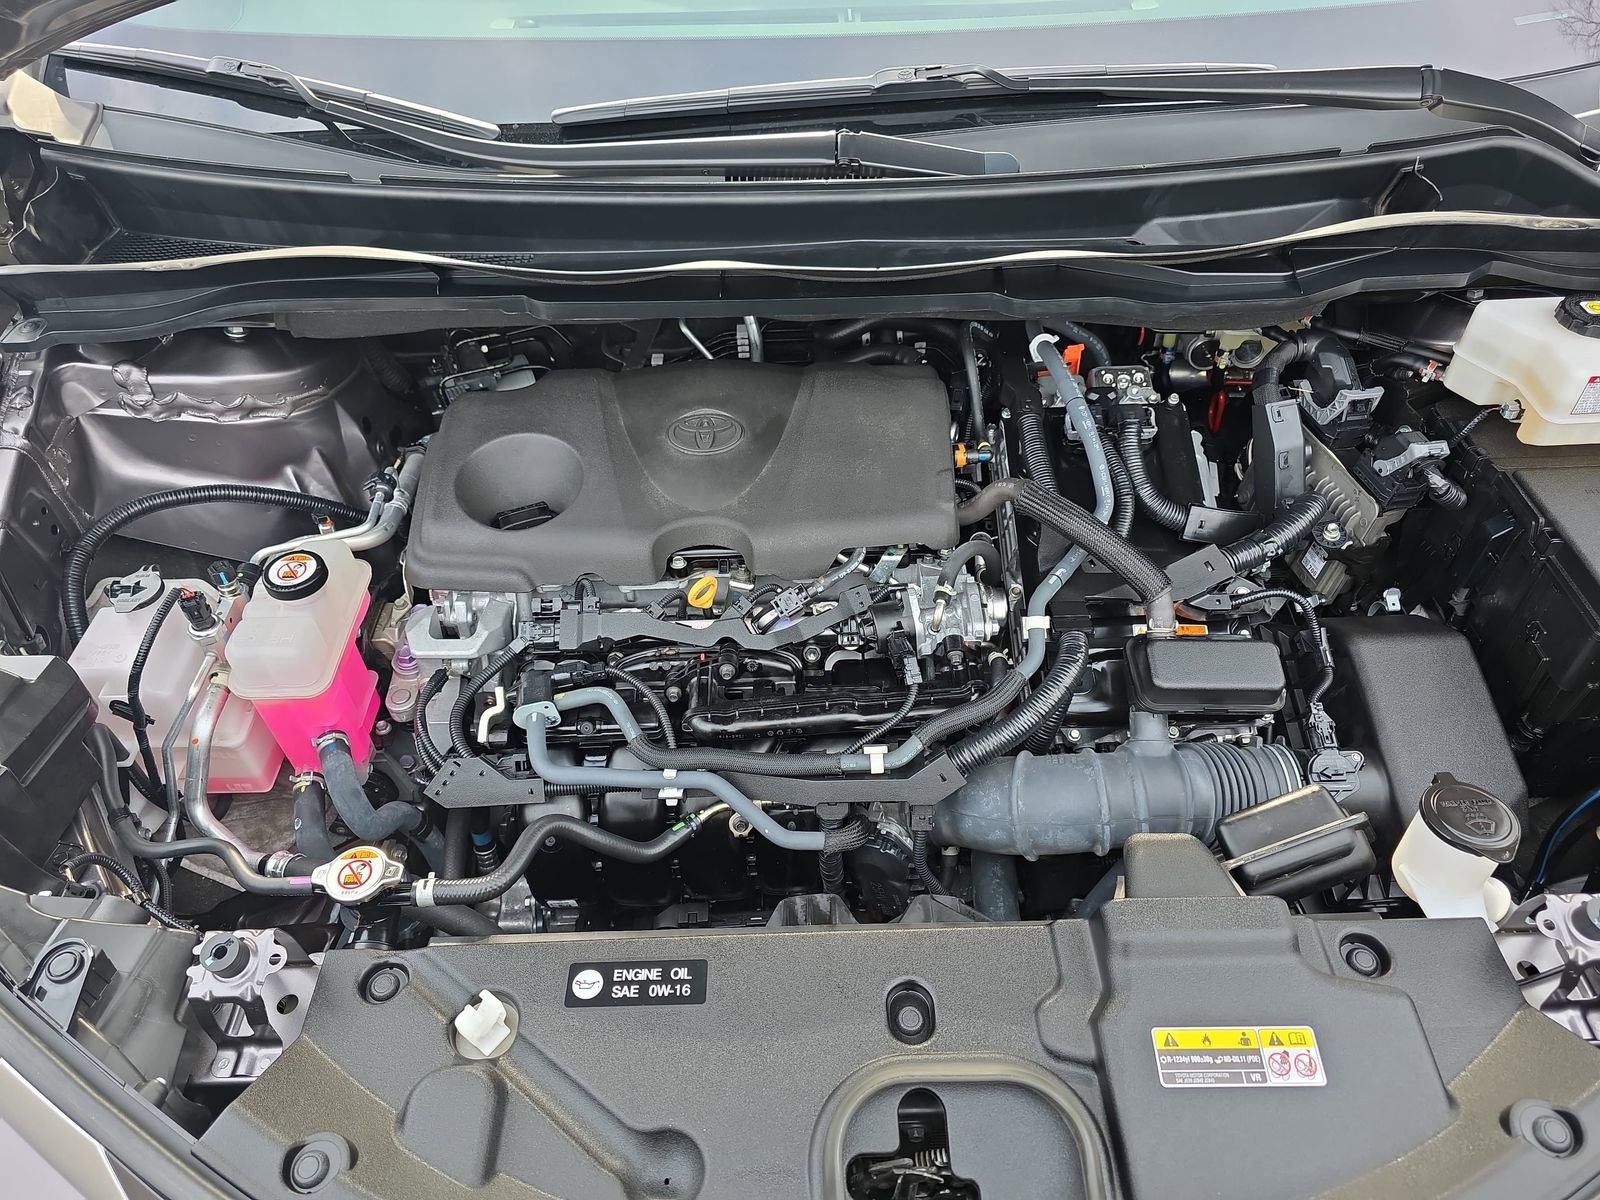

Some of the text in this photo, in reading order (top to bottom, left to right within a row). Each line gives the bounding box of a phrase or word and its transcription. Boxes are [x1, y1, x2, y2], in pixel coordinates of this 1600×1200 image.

[613, 967, 693, 982] ENGINE OIL
[611, 984, 691, 998] SAE 0W-16
[1250, 1073, 1262, 1082] VR
